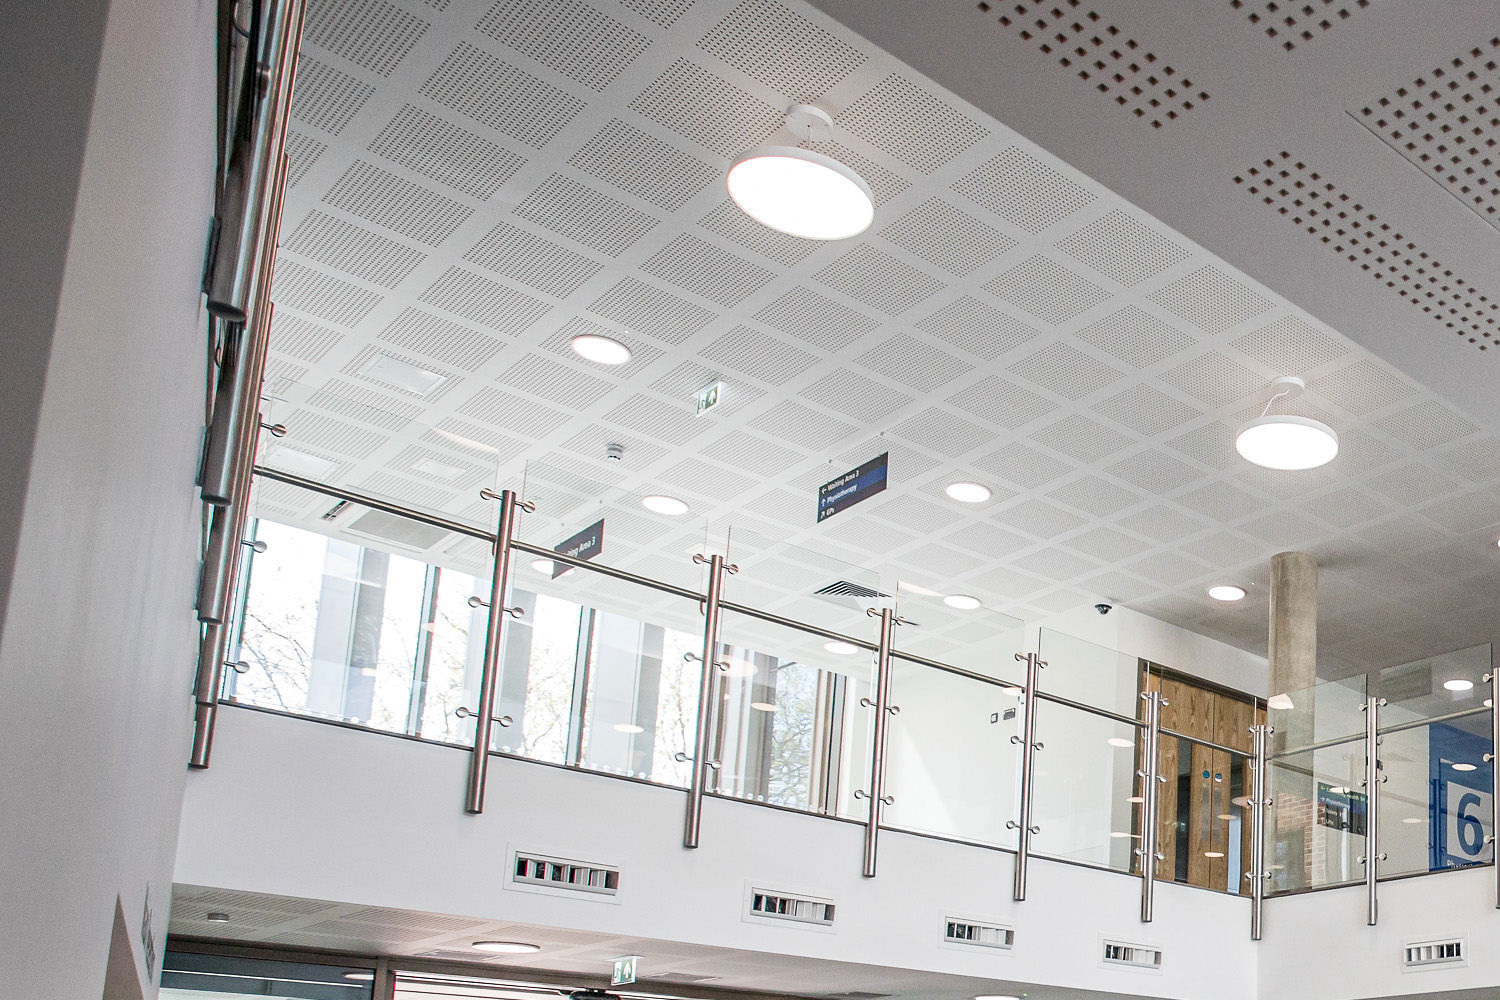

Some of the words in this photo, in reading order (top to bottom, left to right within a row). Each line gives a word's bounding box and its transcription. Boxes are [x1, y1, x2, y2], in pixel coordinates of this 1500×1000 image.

[827, 478, 845, 491] Waiting
[844, 473, 856, 483] Area
[855, 469, 860, 478] 3
[578, 540, 592, 553] Area
[591, 536, 597, 546] 3
[1456, 792, 1485, 857] 6
